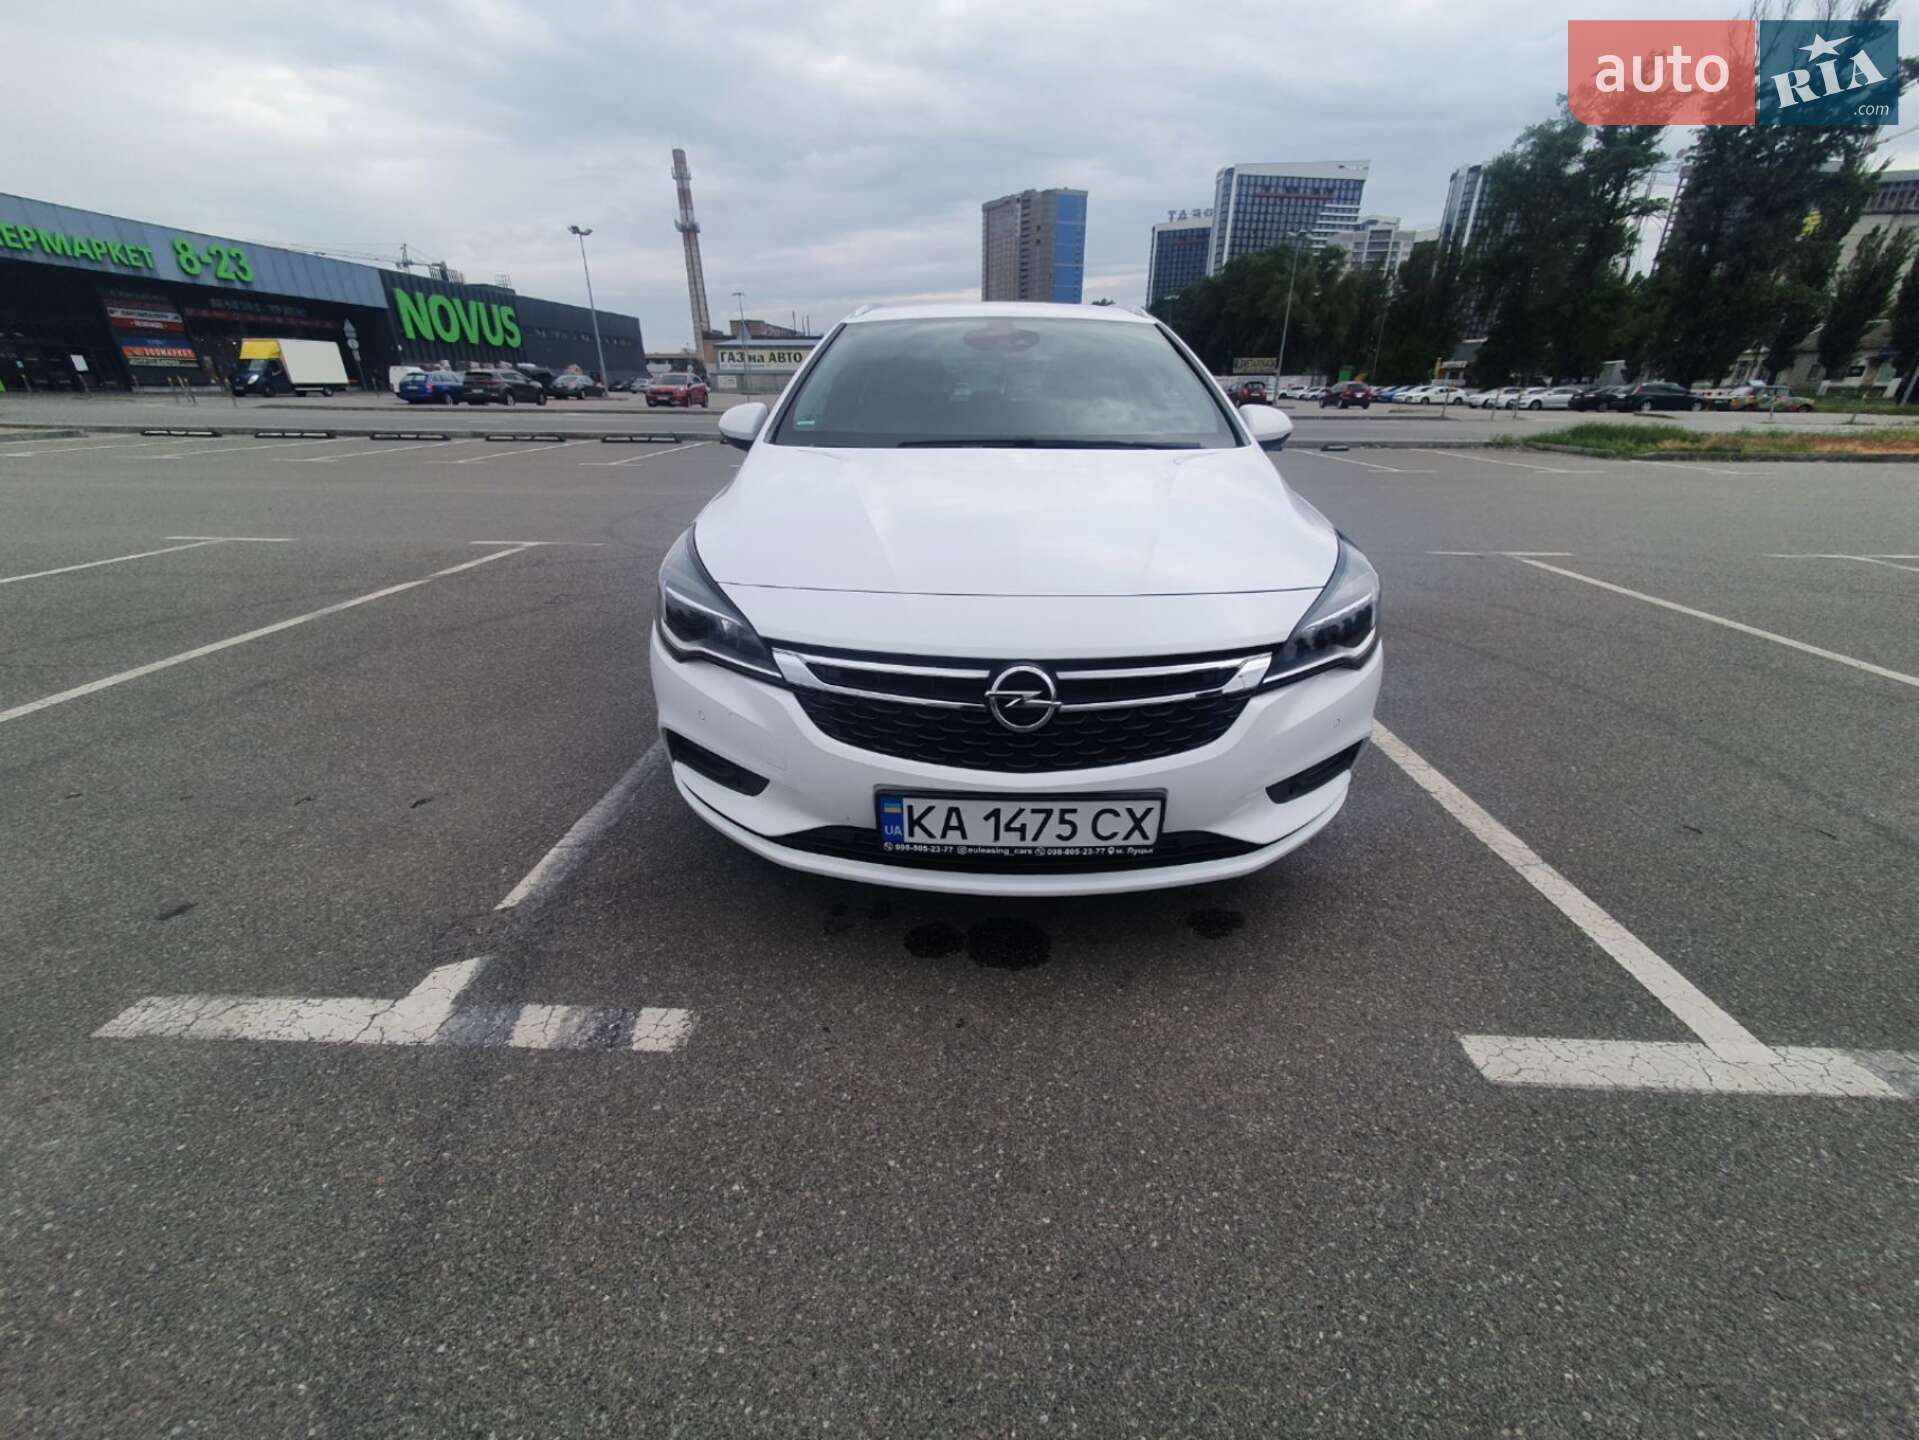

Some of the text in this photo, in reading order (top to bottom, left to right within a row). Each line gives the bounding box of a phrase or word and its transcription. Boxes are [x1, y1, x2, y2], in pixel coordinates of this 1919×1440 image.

[172, 237, 254, 283] 8-23
[393, 287, 522, 348] NOVUS
[720, 351, 745, 363] ГАЗ
[768, 351, 803, 364] АВТО
[884, 825, 902, 836] UA
[906, 804, 1154, 843] KA 1475 CX
